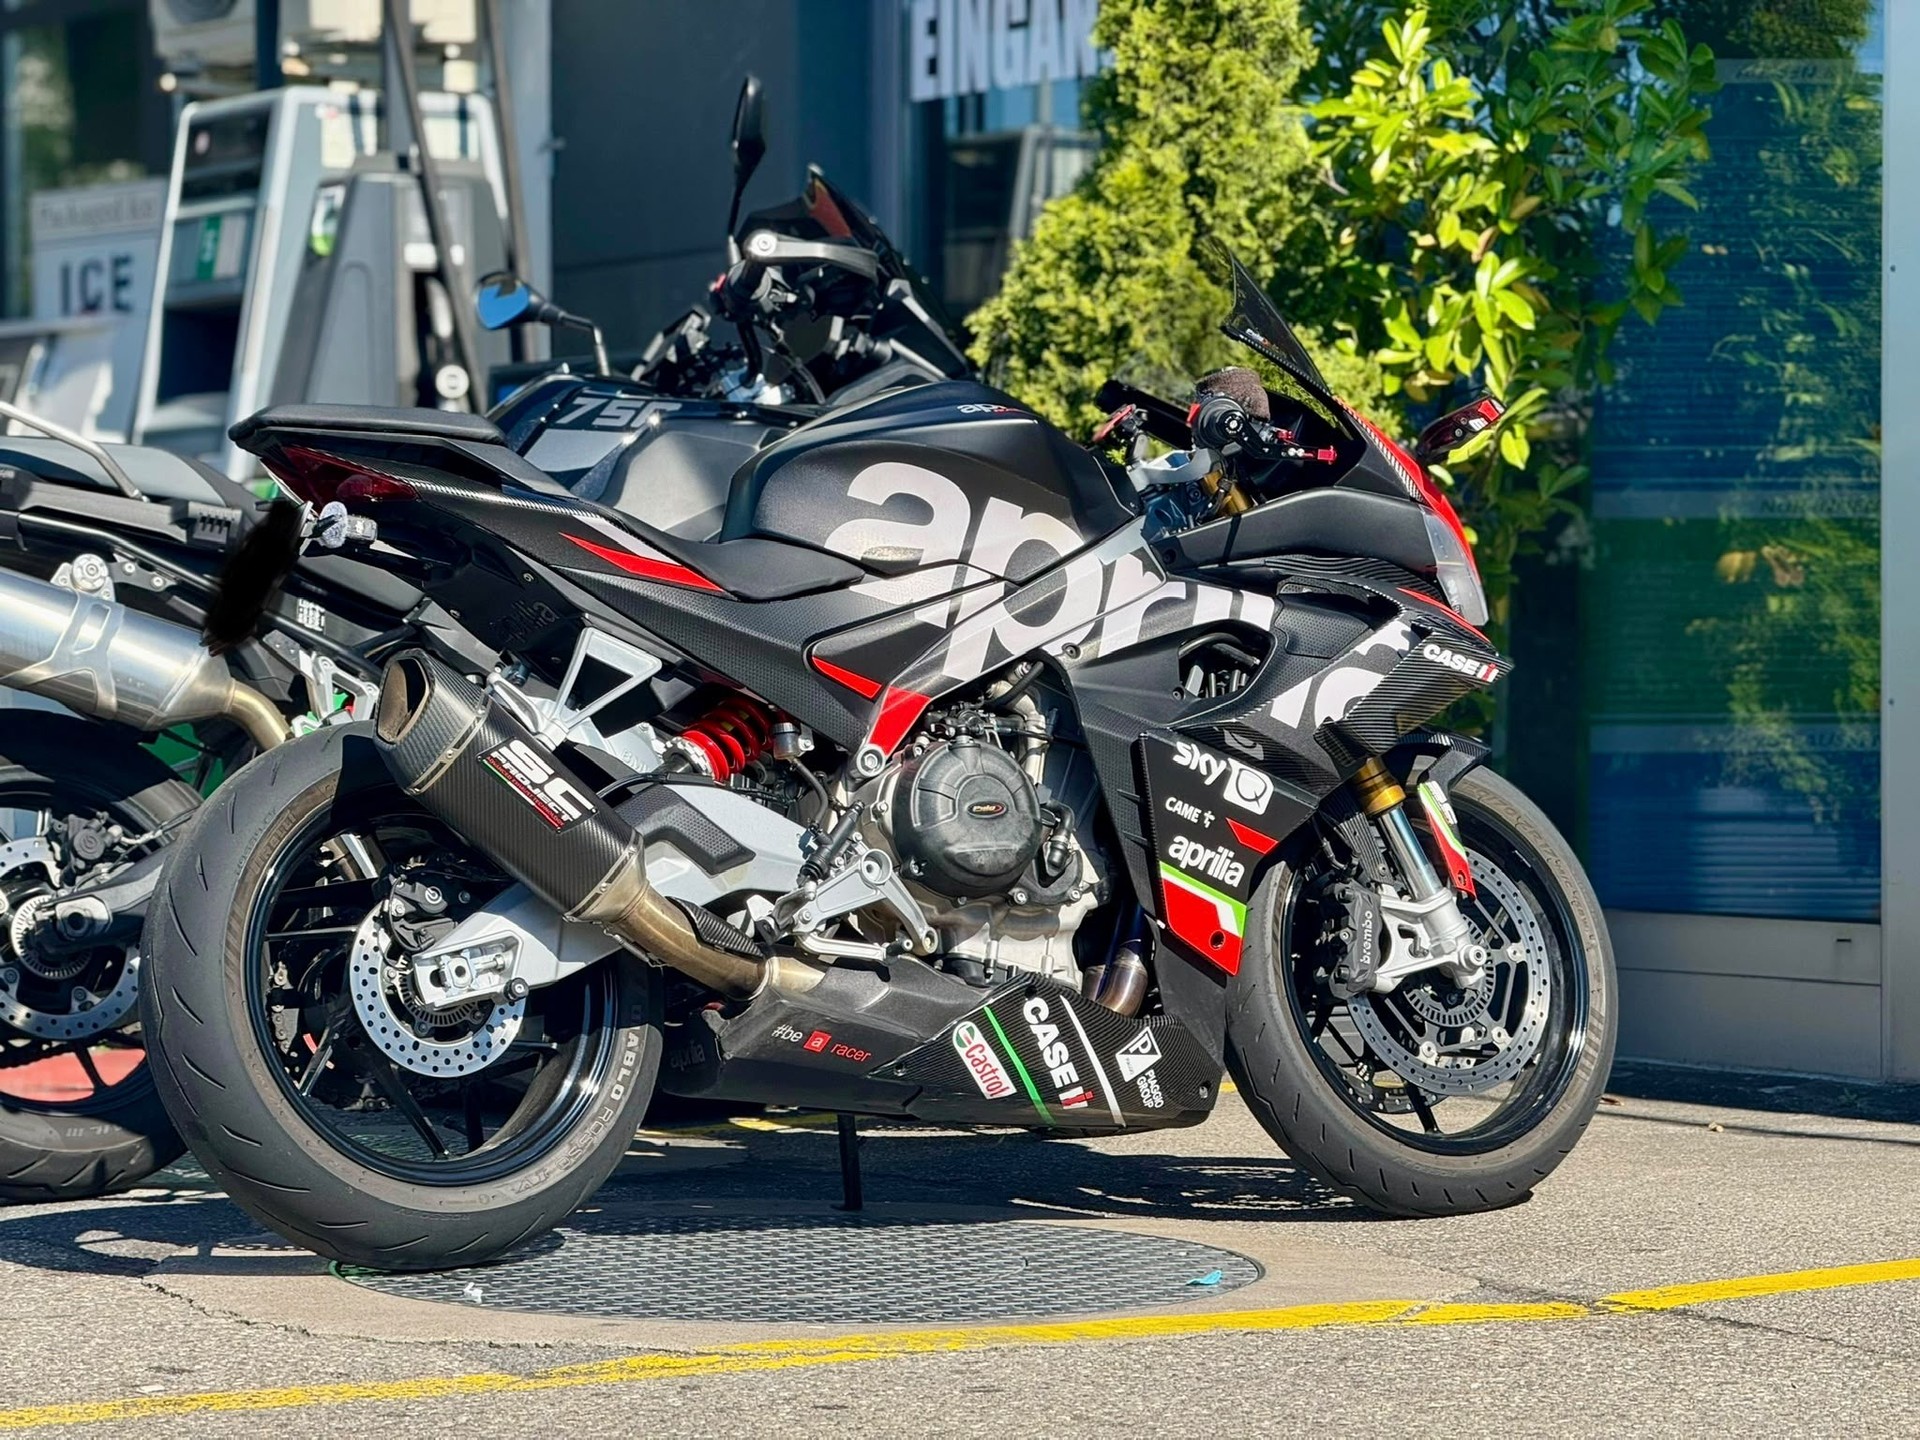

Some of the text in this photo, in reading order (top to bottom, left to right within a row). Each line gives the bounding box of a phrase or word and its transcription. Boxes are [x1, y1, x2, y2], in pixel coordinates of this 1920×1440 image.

[910, 0, 1112, 101] EINGAN
[61, 254, 133, 317] ICE
[1423, 643, 1480, 676] CASE
[490, 751, 574, 822] PROJECT
[1172, 741, 1227, 786] sky
[1165, 796, 1202, 823] CAME
[1168, 835, 1245, 888] aprilia
[1360, 910, 1373, 965] brembo
[771, 1023, 803, 1043] #be
[830, 1043, 872, 1062] racer
[1022, 996, 1080, 1089] CASE
[964, 1043, 1011, 1098] Castrol
[1136, 1076, 1154, 1108] GROUP
[1144, 1069, 1164, 1108] PIAGGIO
[555, 1106, 614, 1171] ROSSO
